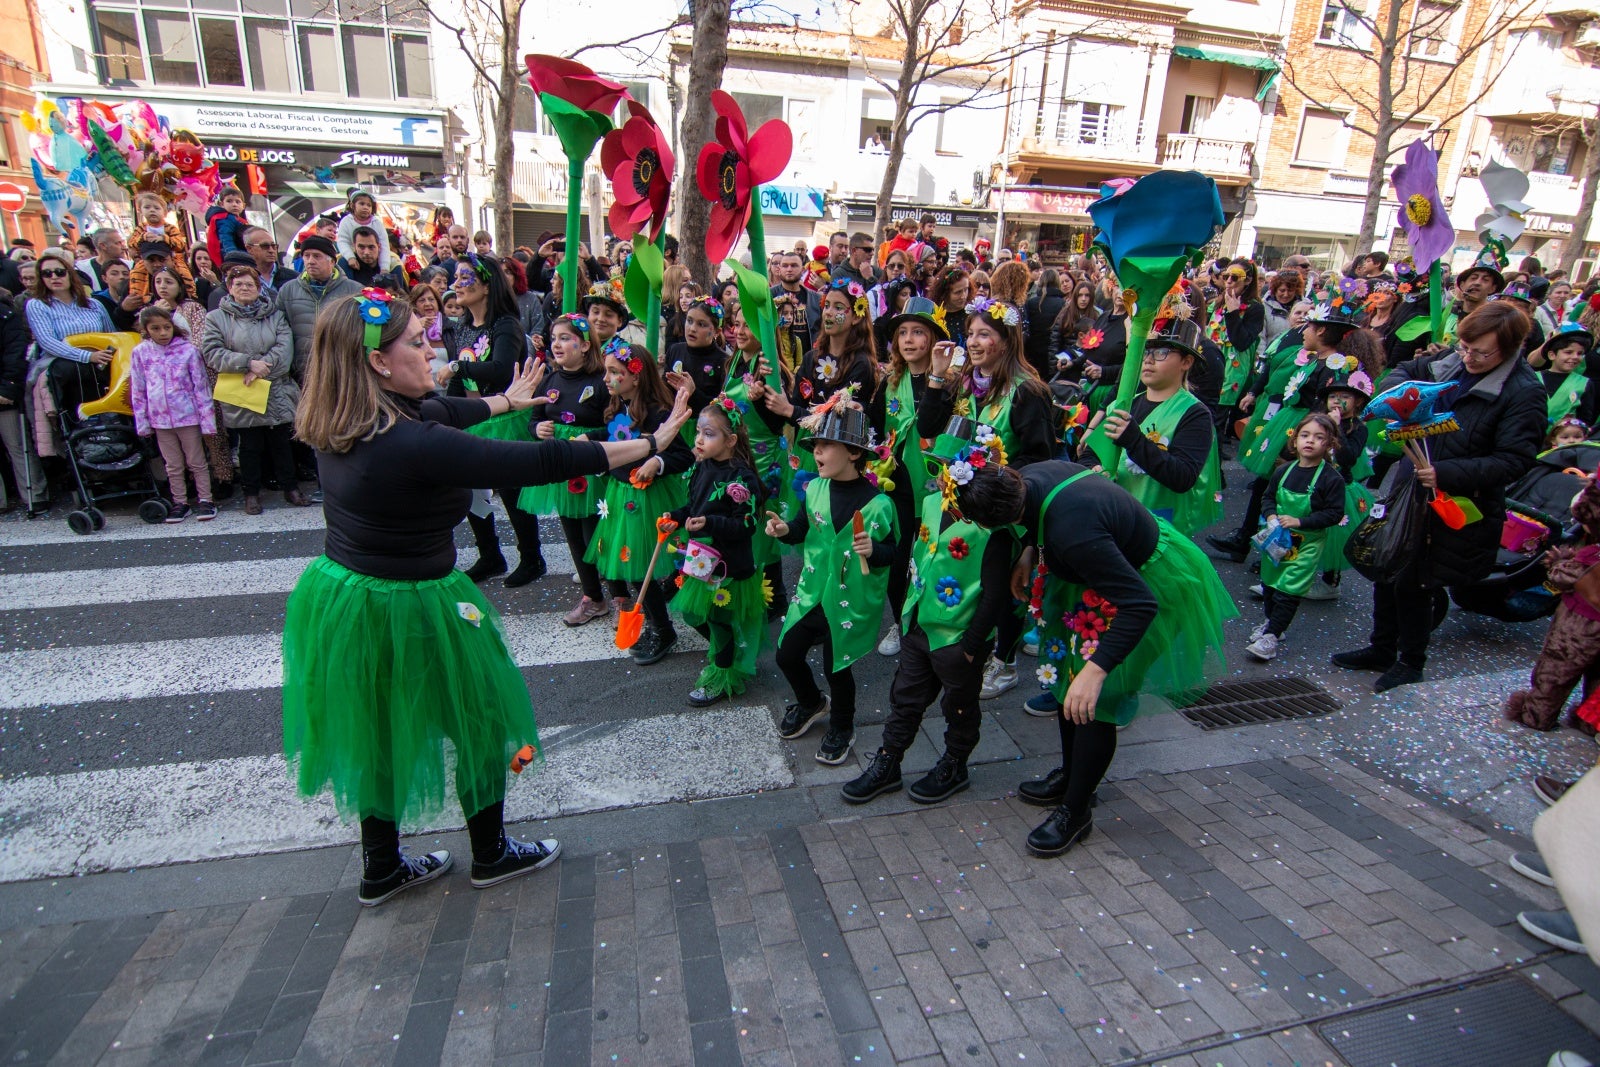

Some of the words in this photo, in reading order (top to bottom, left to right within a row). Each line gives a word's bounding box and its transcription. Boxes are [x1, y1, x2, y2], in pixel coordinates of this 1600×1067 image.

[247, 111, 282, 120] Laboral
[288, 113, 315, 122] Fiscal
[323, 115, 373, 126] Comptable
[198, 119, 247, 129] Corredoria
[331, 126, 369, 136] Gestoria
[240, 148, 258, 162] DE
[261, 150, 296, 164] JOCS
[761, 190, 799, 210] GRAU
[1520, 213, 1551, 231] YIN
